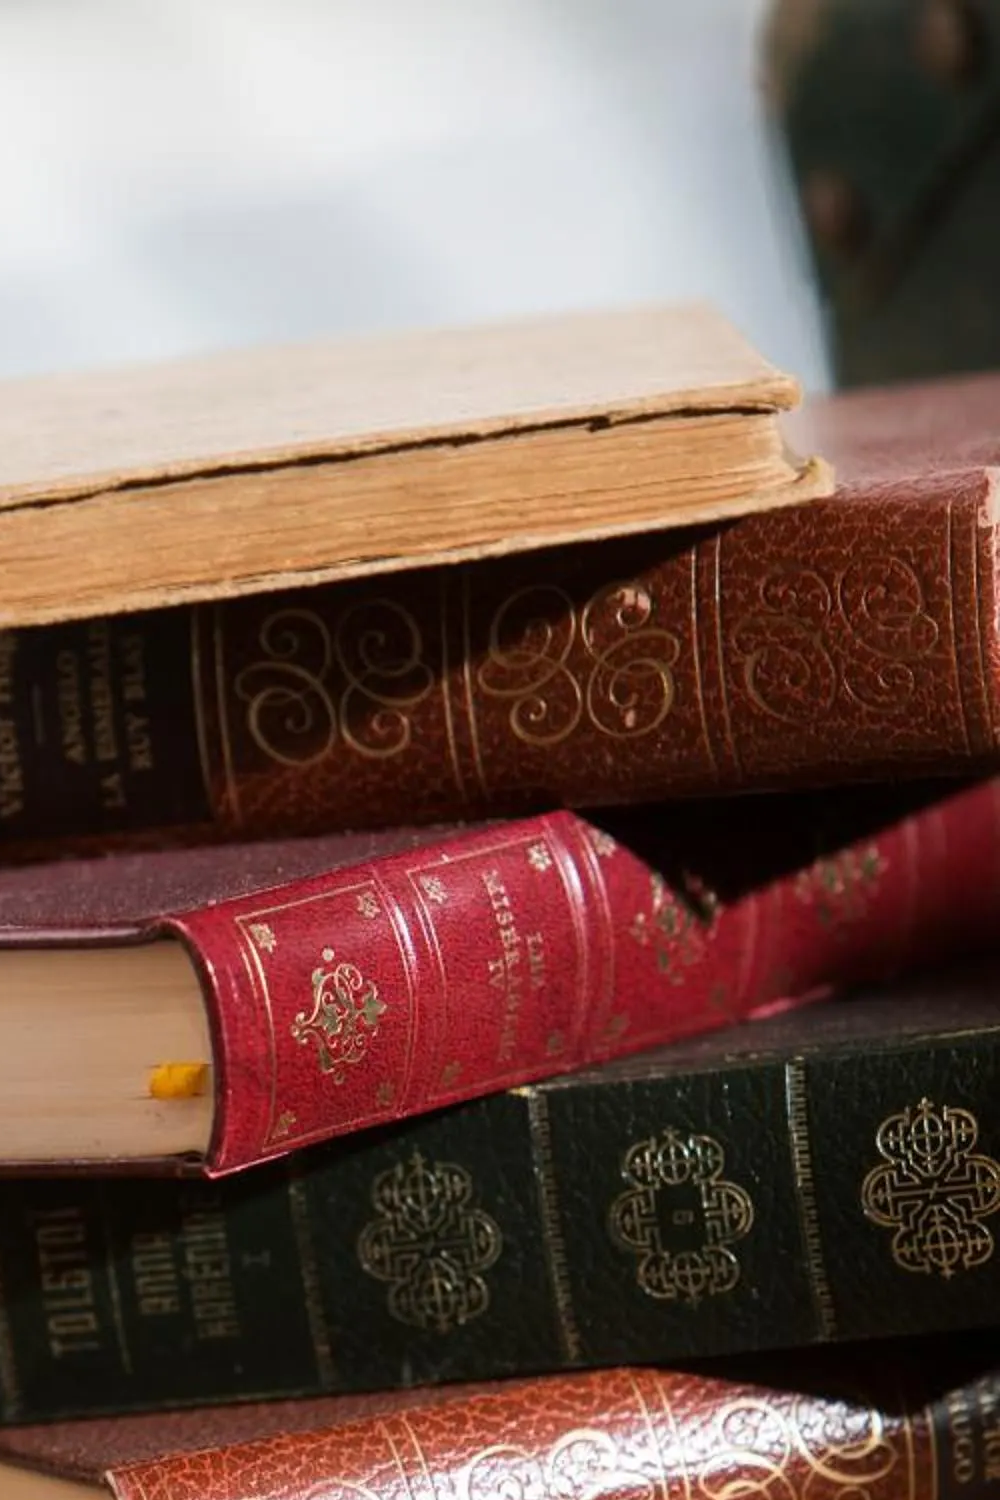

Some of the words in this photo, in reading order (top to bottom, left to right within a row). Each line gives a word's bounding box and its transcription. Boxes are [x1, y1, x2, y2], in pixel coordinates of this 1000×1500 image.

[125, 712, 154, 771] RUY
[130, 1230, 181, 1316] ANNA
[945, 1387, 975, 1485] HUGO
